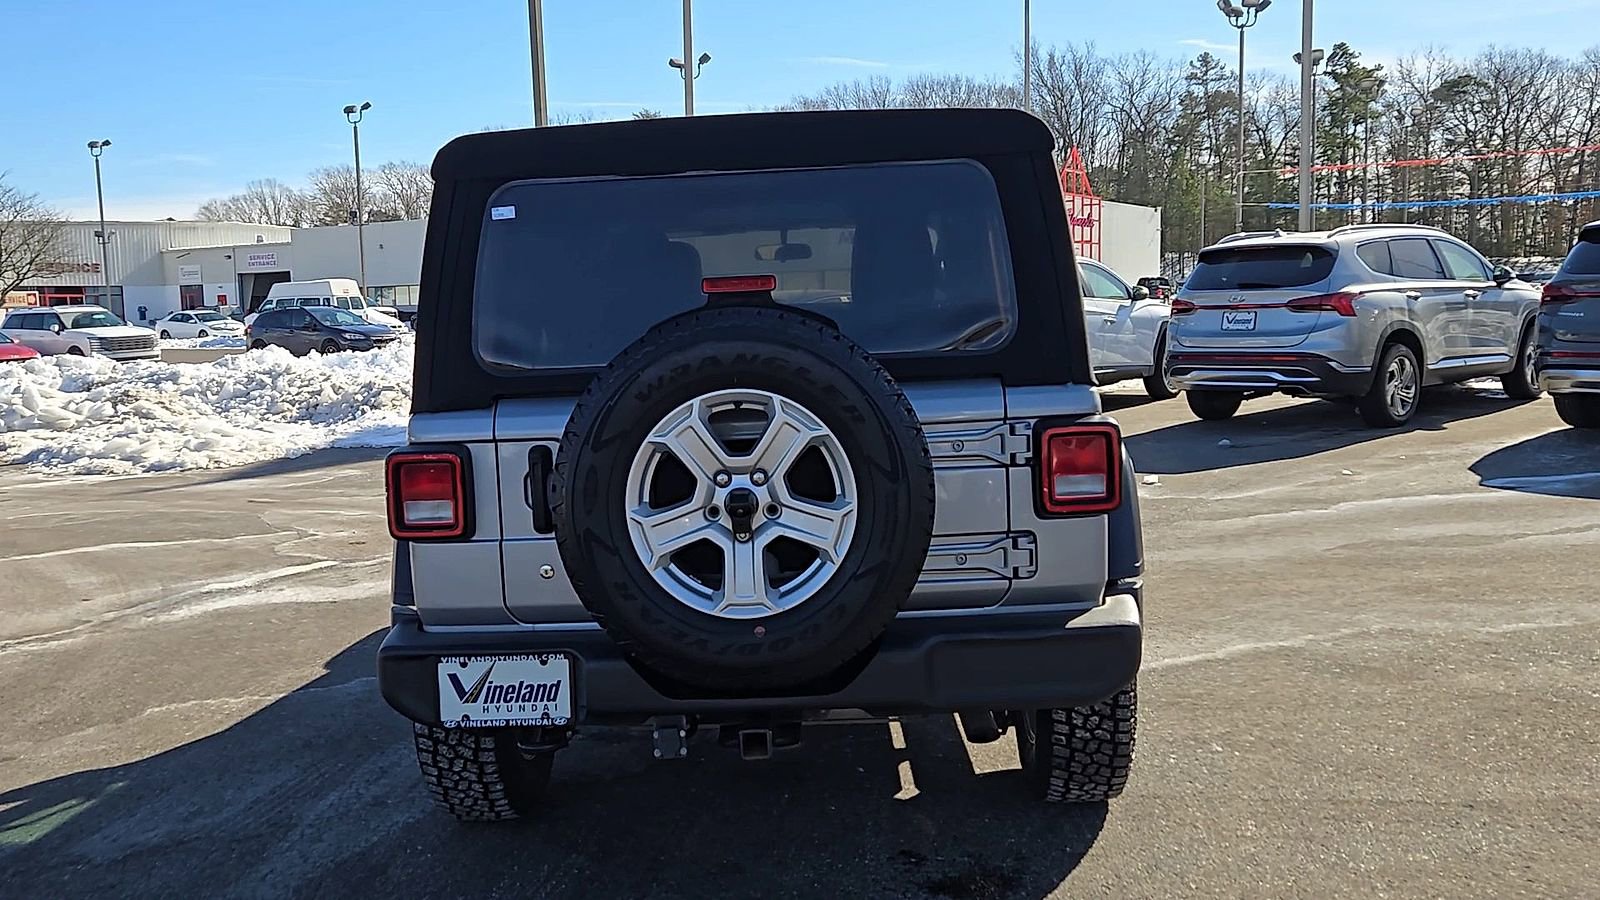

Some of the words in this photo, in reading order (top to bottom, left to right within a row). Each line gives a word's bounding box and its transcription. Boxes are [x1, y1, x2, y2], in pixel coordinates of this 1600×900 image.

[249, 253, 275, 261] SERVICE
[441, 654, 565, 664] VINELANDHYUNDAI.COM
[447, 661, 562, 704] Vineland
[482, 703, 559, 714] HYUNDAI
[459, 719, 506, 728] VINELAND
[509, 717, 552, 727] HYUNDAI
